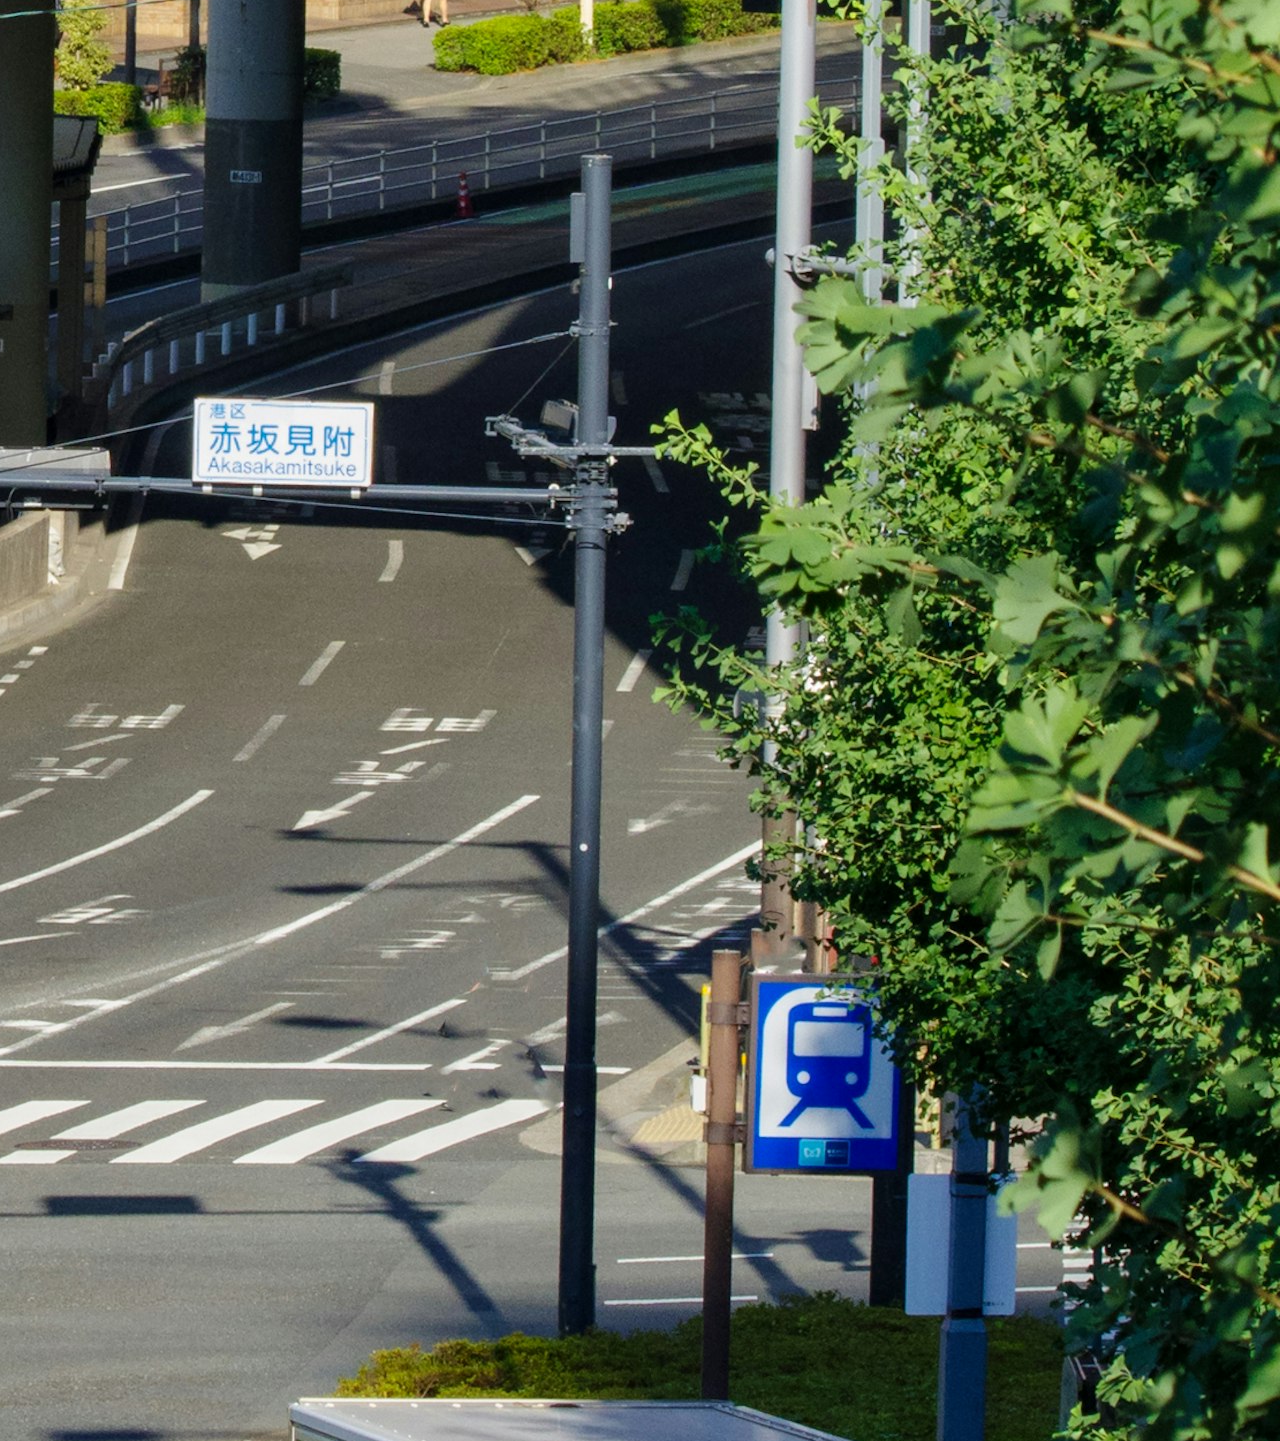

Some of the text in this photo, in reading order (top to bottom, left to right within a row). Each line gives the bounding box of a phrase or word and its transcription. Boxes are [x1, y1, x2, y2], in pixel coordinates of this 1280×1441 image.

[209, 402, 247, 420] 港区
[209, 422, 356, 458] 赤坂見附
[207, 457, 358, 478] Akasakamitsuke
